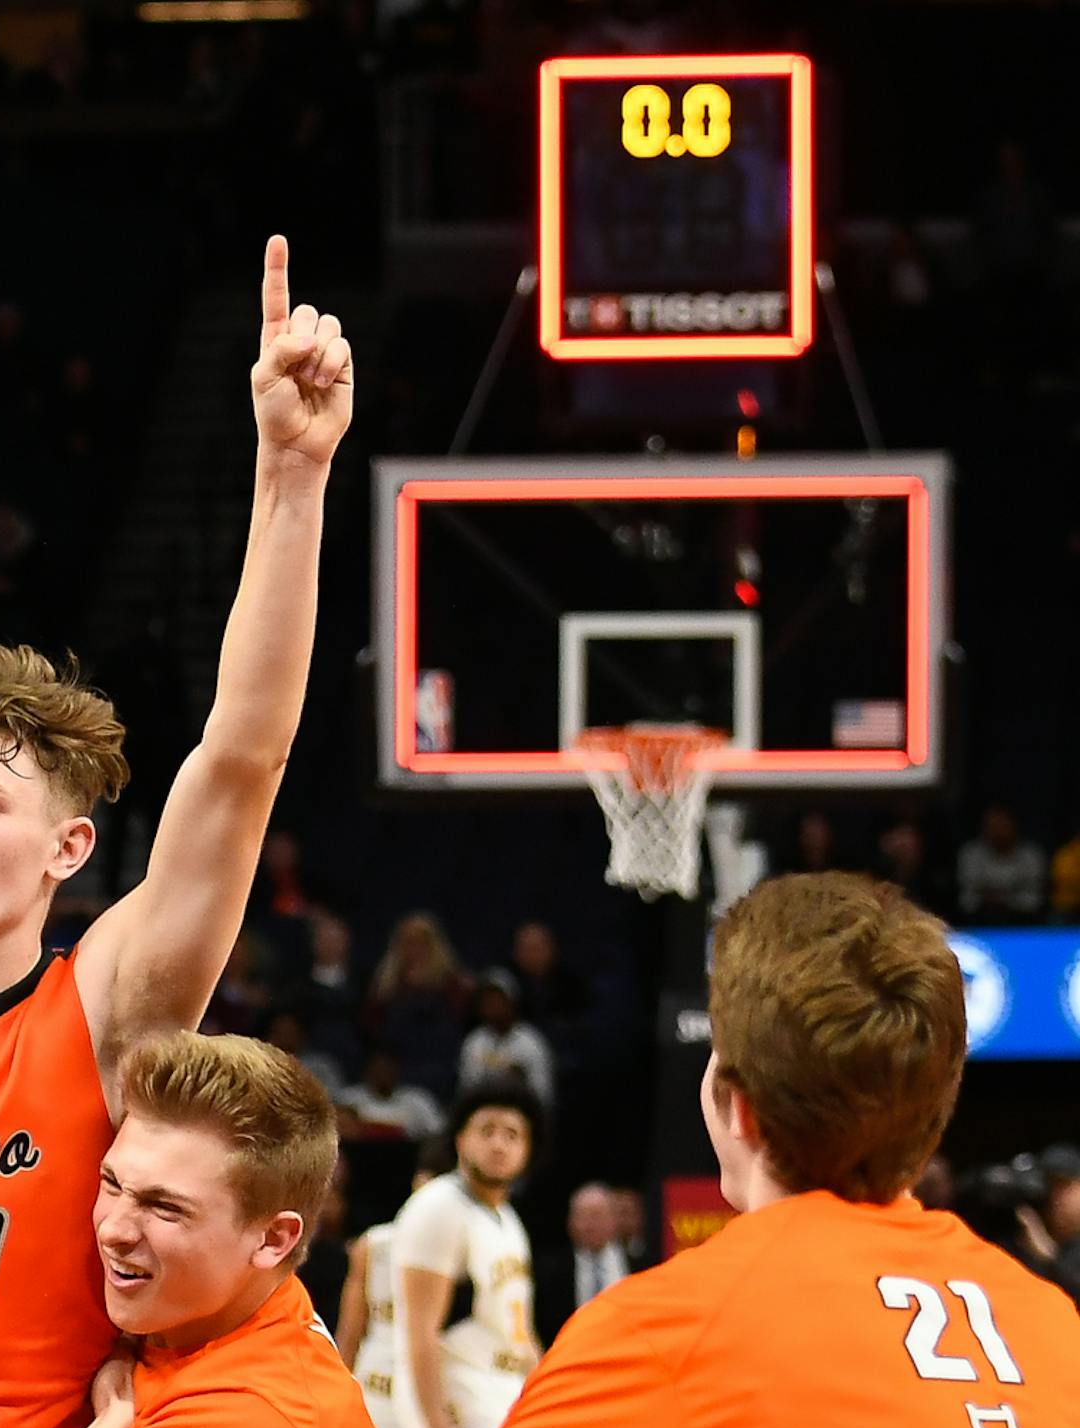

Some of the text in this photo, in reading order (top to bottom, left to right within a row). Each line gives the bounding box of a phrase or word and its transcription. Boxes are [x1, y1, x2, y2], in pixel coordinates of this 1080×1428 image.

[622, 83, 732, 158] 0.0
[623, 291, 786, 332] TISSOT
[876, 1275, 1025, 1385] 21
